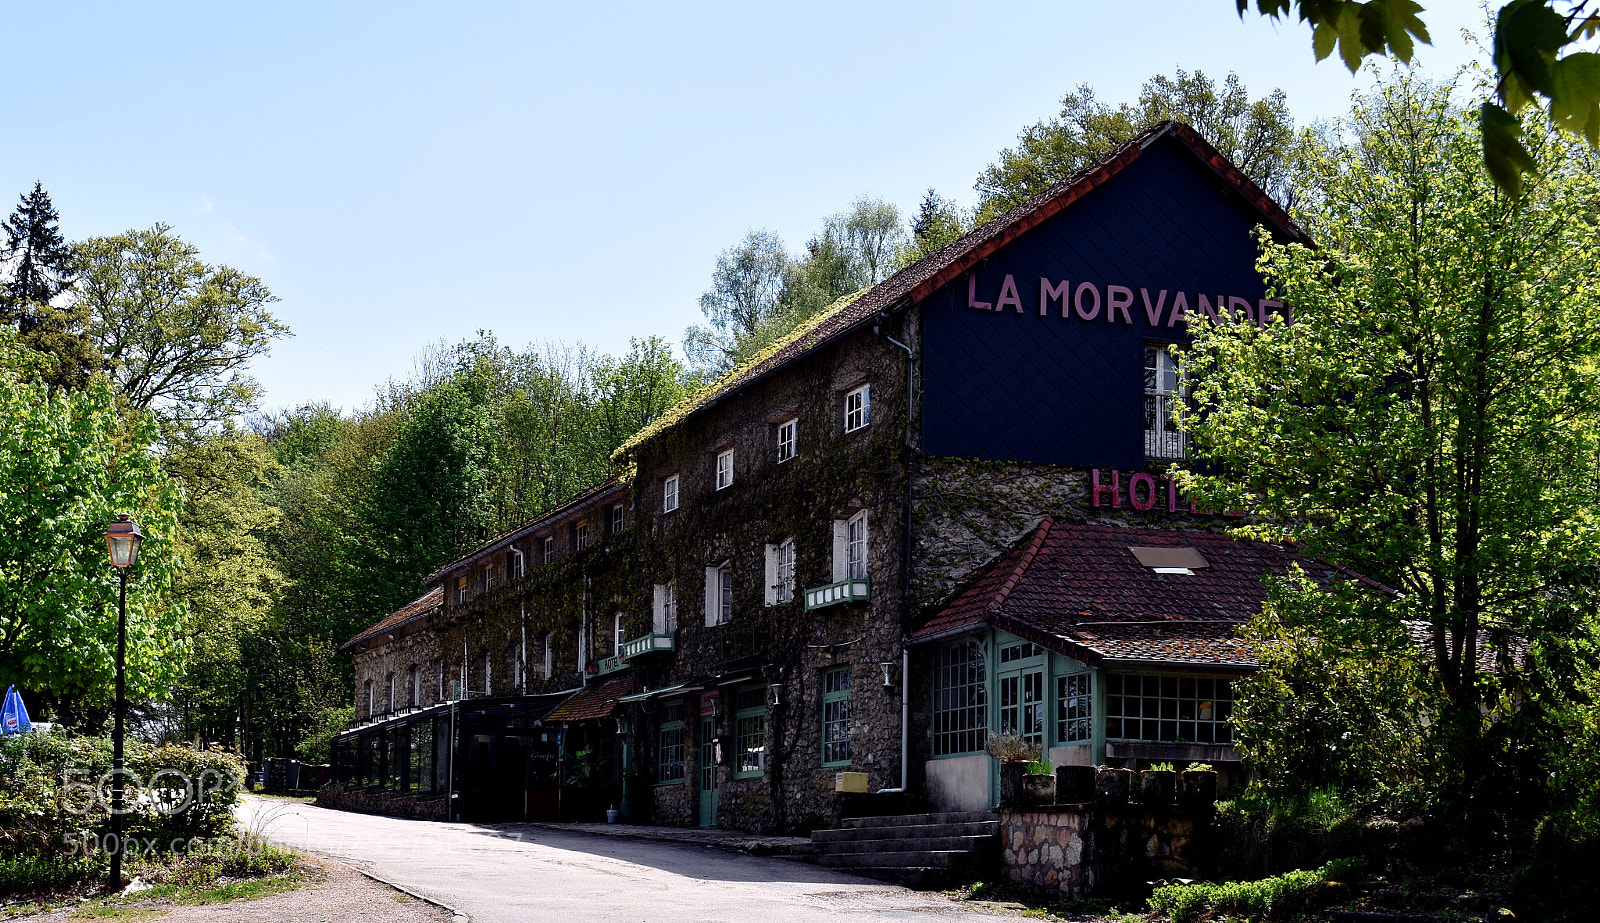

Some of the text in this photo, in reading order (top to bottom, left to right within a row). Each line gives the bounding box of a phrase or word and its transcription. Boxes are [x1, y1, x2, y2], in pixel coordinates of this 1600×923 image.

[968, 271, 1024, 314] LA
[1092, 468, 1247, 517] HOT
[604, 656, 619, 671] HOTEL
